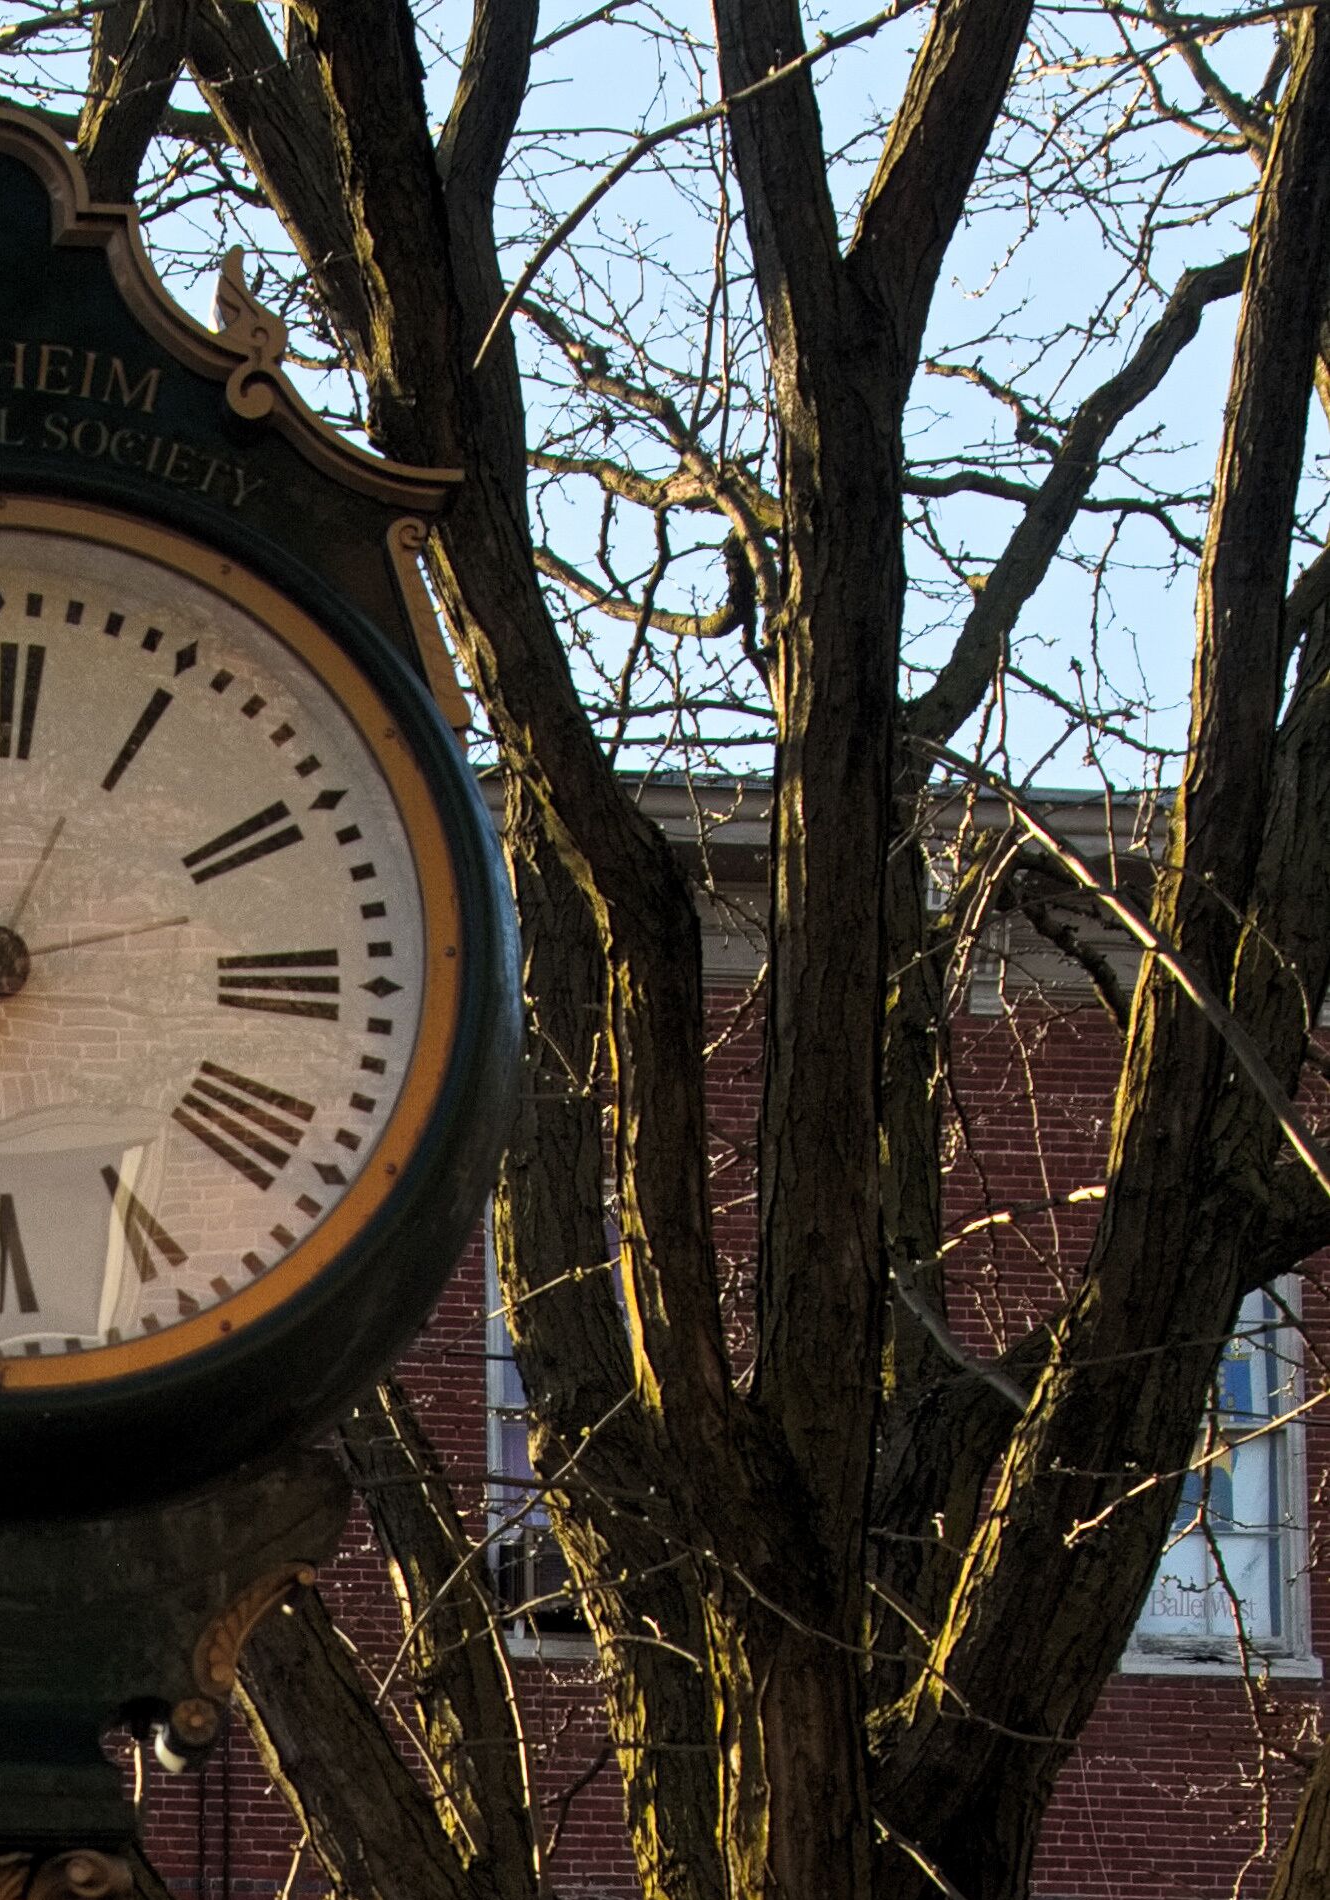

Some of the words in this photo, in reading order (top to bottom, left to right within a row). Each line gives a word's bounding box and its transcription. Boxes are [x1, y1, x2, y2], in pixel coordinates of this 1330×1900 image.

[41, 411, 265, 508] SOCIETY
[181, 799, 306, 885] II
[216, 949, 340, 1022] III
[101, 1164, 189, 1282] V
[1210, 1592, 1256, 1620] Wst
